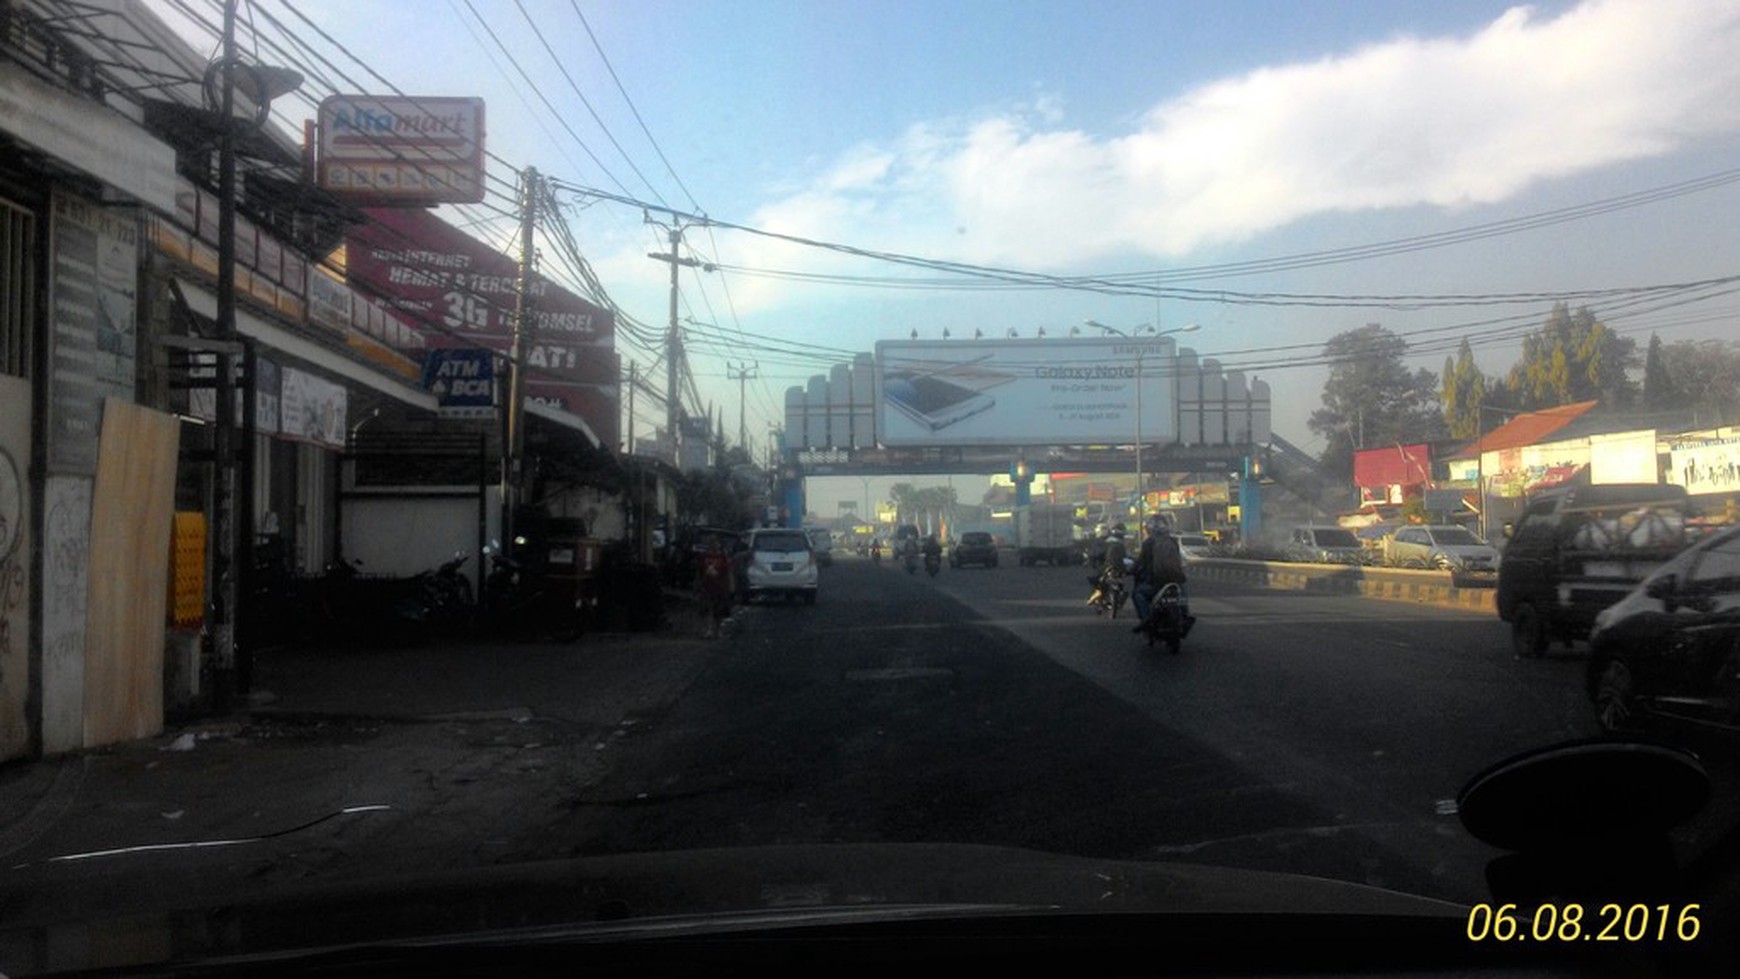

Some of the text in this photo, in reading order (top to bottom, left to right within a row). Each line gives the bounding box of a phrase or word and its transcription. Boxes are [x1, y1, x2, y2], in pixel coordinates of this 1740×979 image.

[332, 107, 467, 133] Alfamart
[436, 360, 481, 378] ATM
[1035, 366, 1090, 380] Galaxy
[451, 379, 490, 397] BCA
